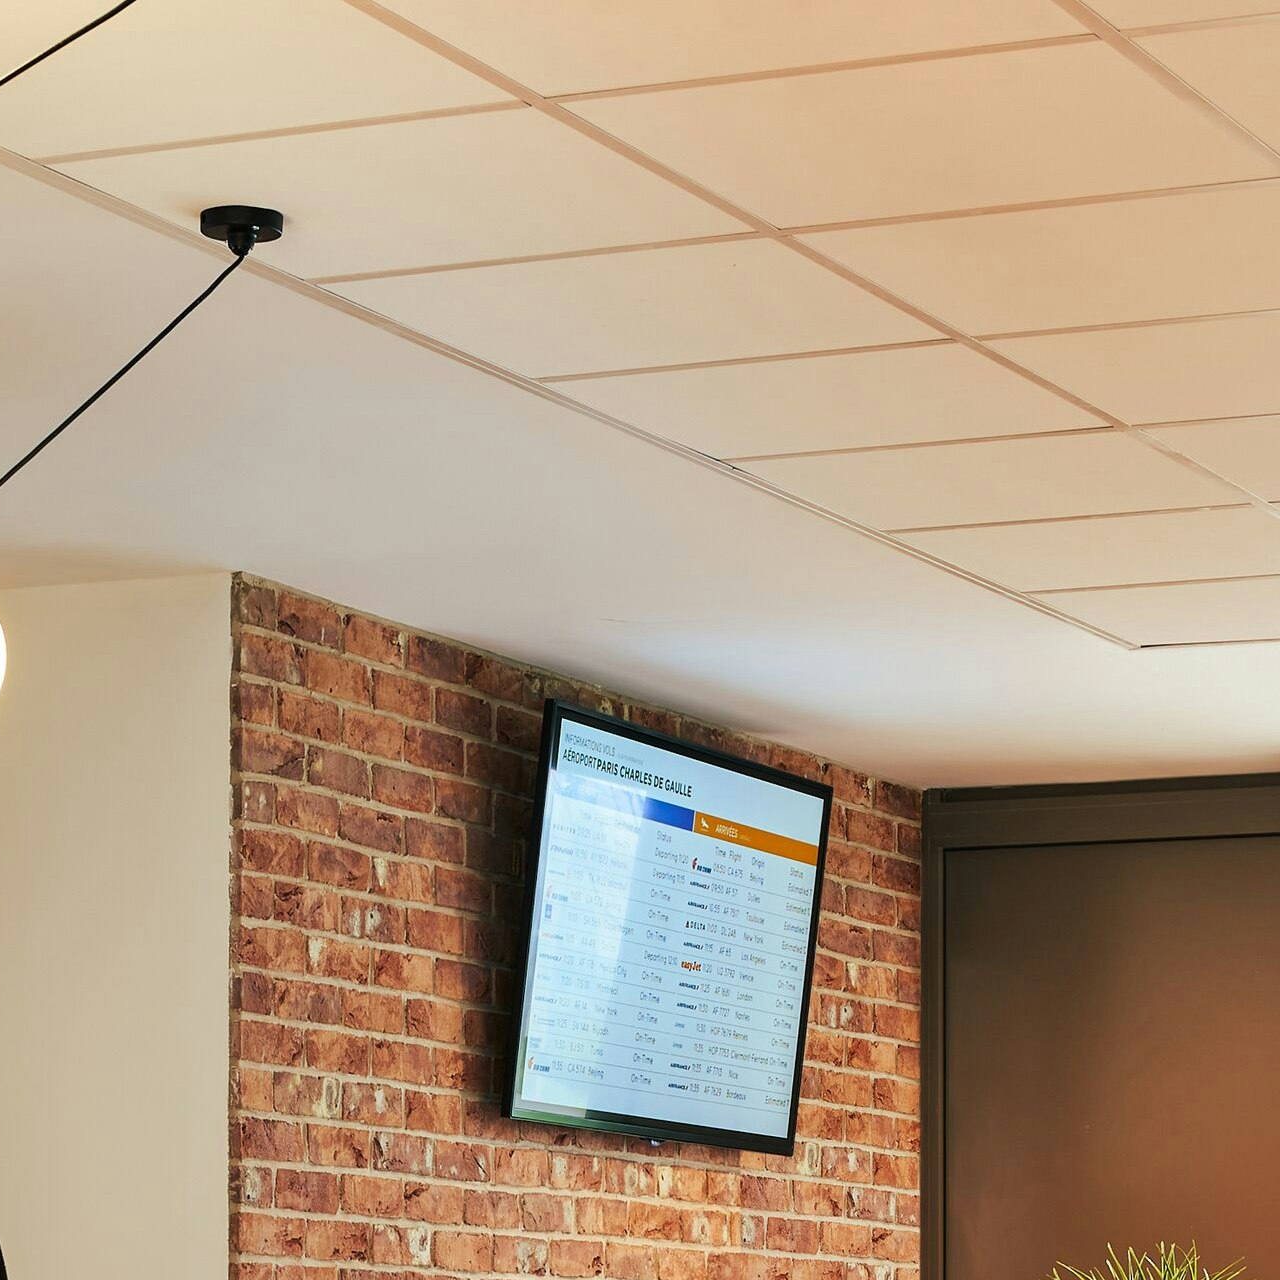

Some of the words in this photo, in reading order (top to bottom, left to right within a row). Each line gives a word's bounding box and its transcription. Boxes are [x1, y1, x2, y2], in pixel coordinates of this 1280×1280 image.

[562, 746, 597, 770] AÉROPORT
[597, 758, 619, 776] PARIS
[619, 765, 652, 786] CHARLES
[653, 775, 664, 790] DE
[664, 778, 692, 798] GAULLE
[715, 822, 738, 839] ARRIVÉES
[680, 959, 702, 974] easyJet
